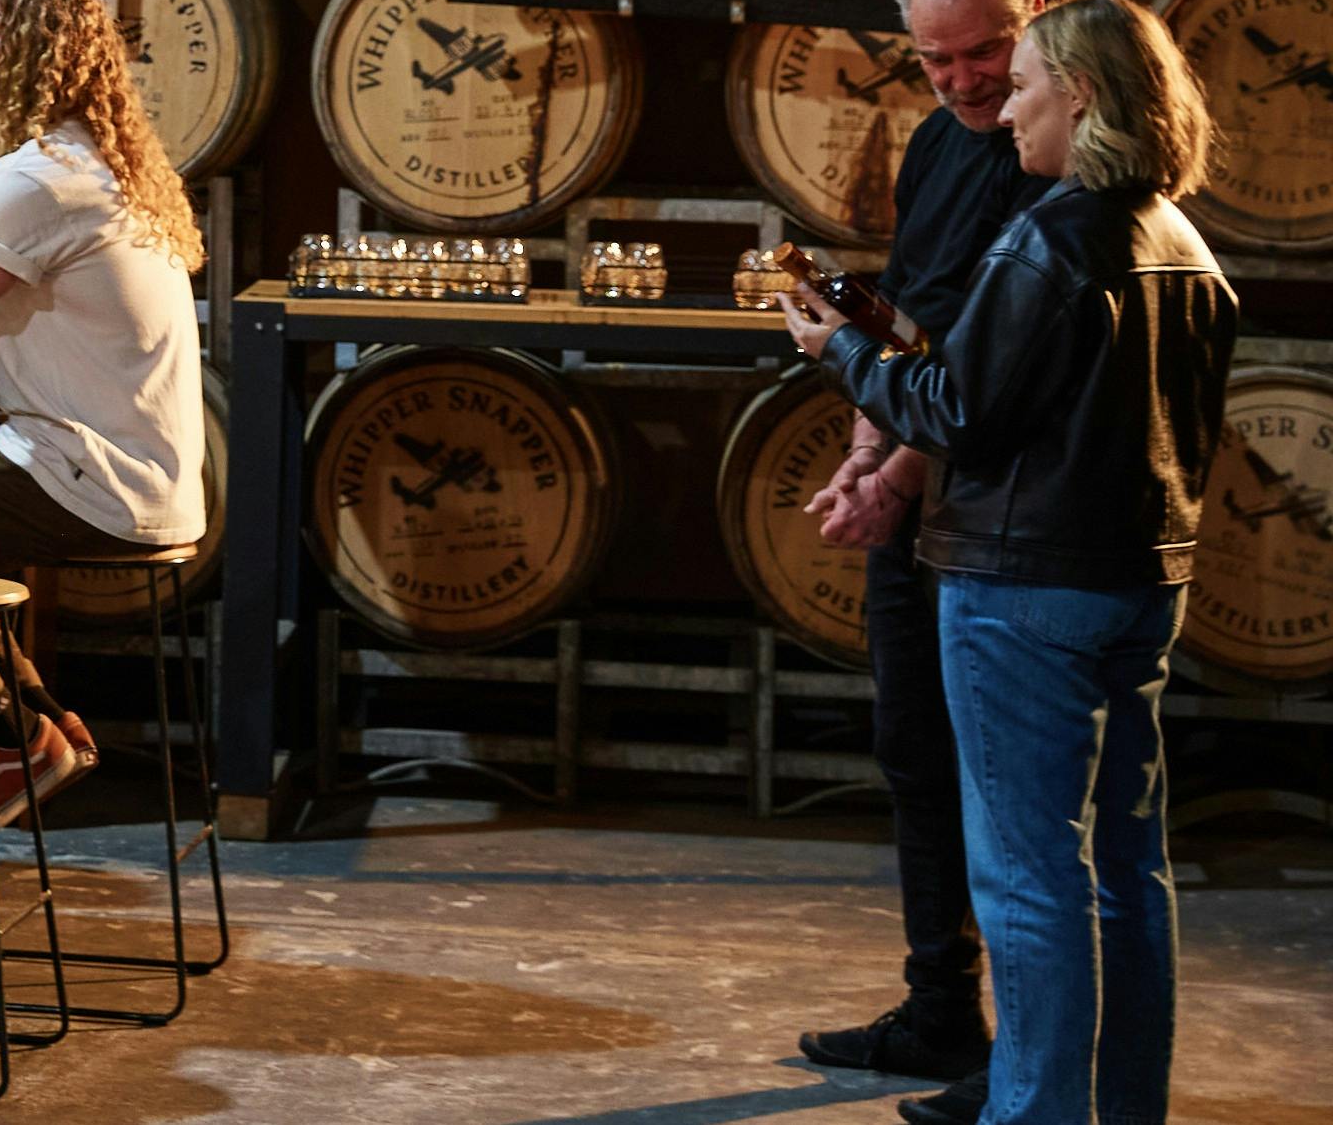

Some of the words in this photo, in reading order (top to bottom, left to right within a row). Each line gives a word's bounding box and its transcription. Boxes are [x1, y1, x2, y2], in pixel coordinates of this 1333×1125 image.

[338, 392, 432, 509] WHIPPER
[449, 386, 557, 492] SNAPPER
[391, 556, 531, 602] DISTILLERY
